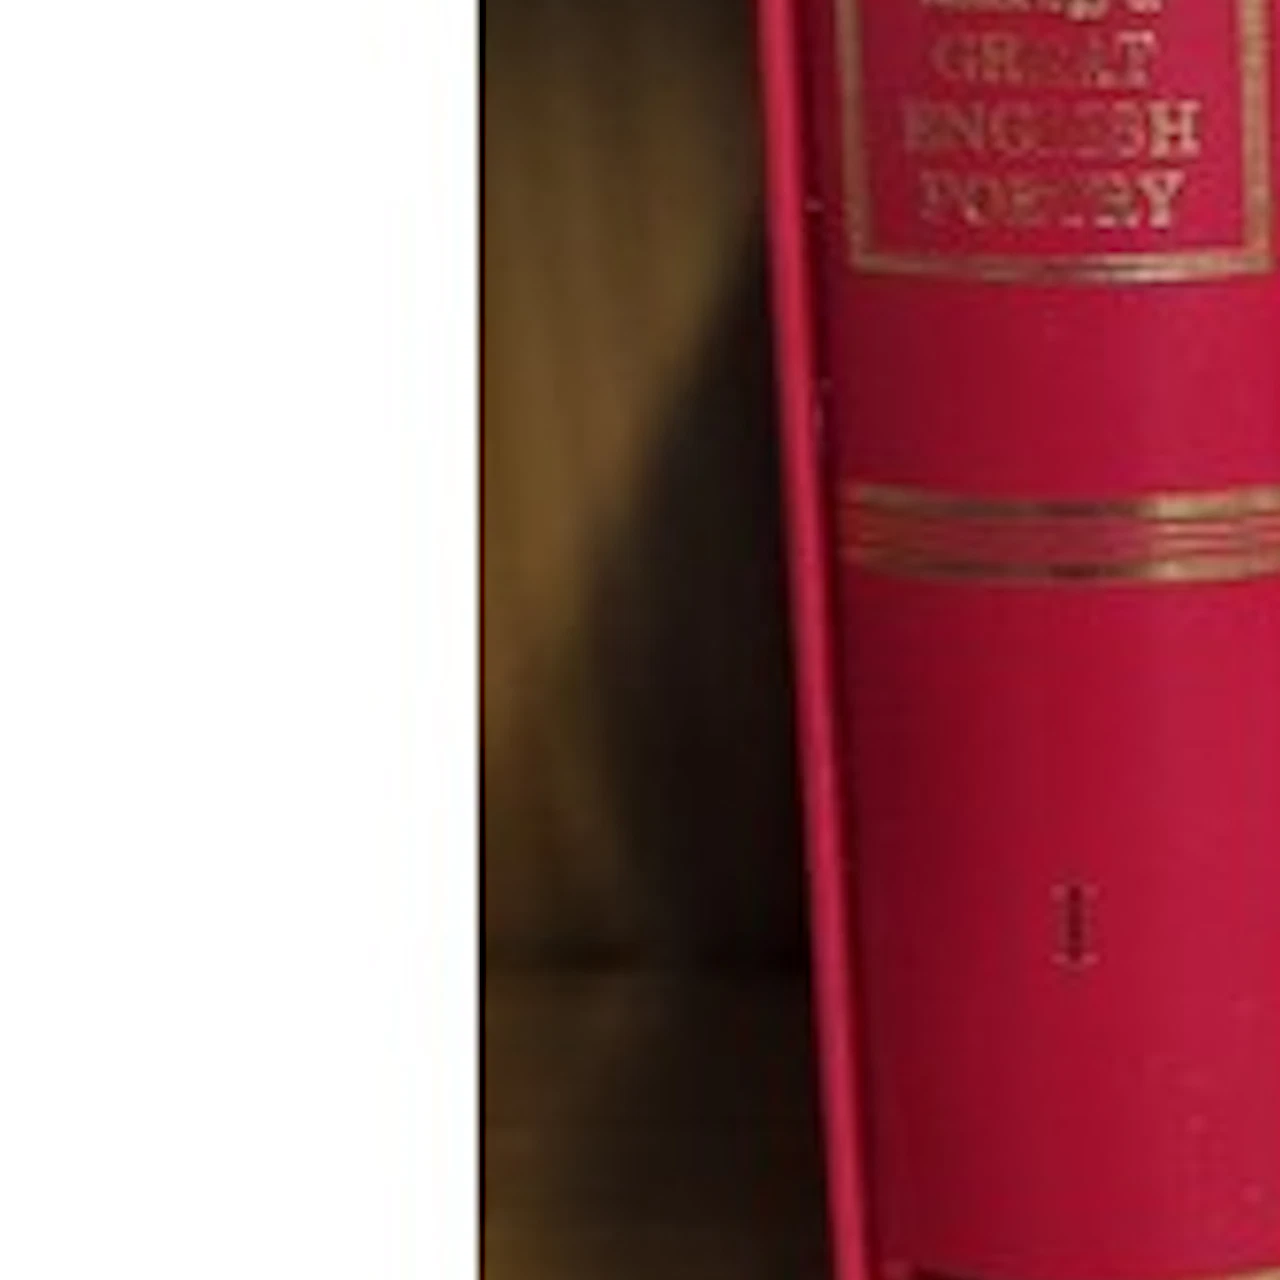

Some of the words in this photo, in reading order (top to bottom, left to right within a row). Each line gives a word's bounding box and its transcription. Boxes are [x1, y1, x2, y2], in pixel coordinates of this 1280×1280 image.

[930, 29, 1159, 88] GRAT
[901, 99, 1202, 158] ENGISH
[918, 168, 1184, 229] POERY
[1050, 883, 1098, 965] I
